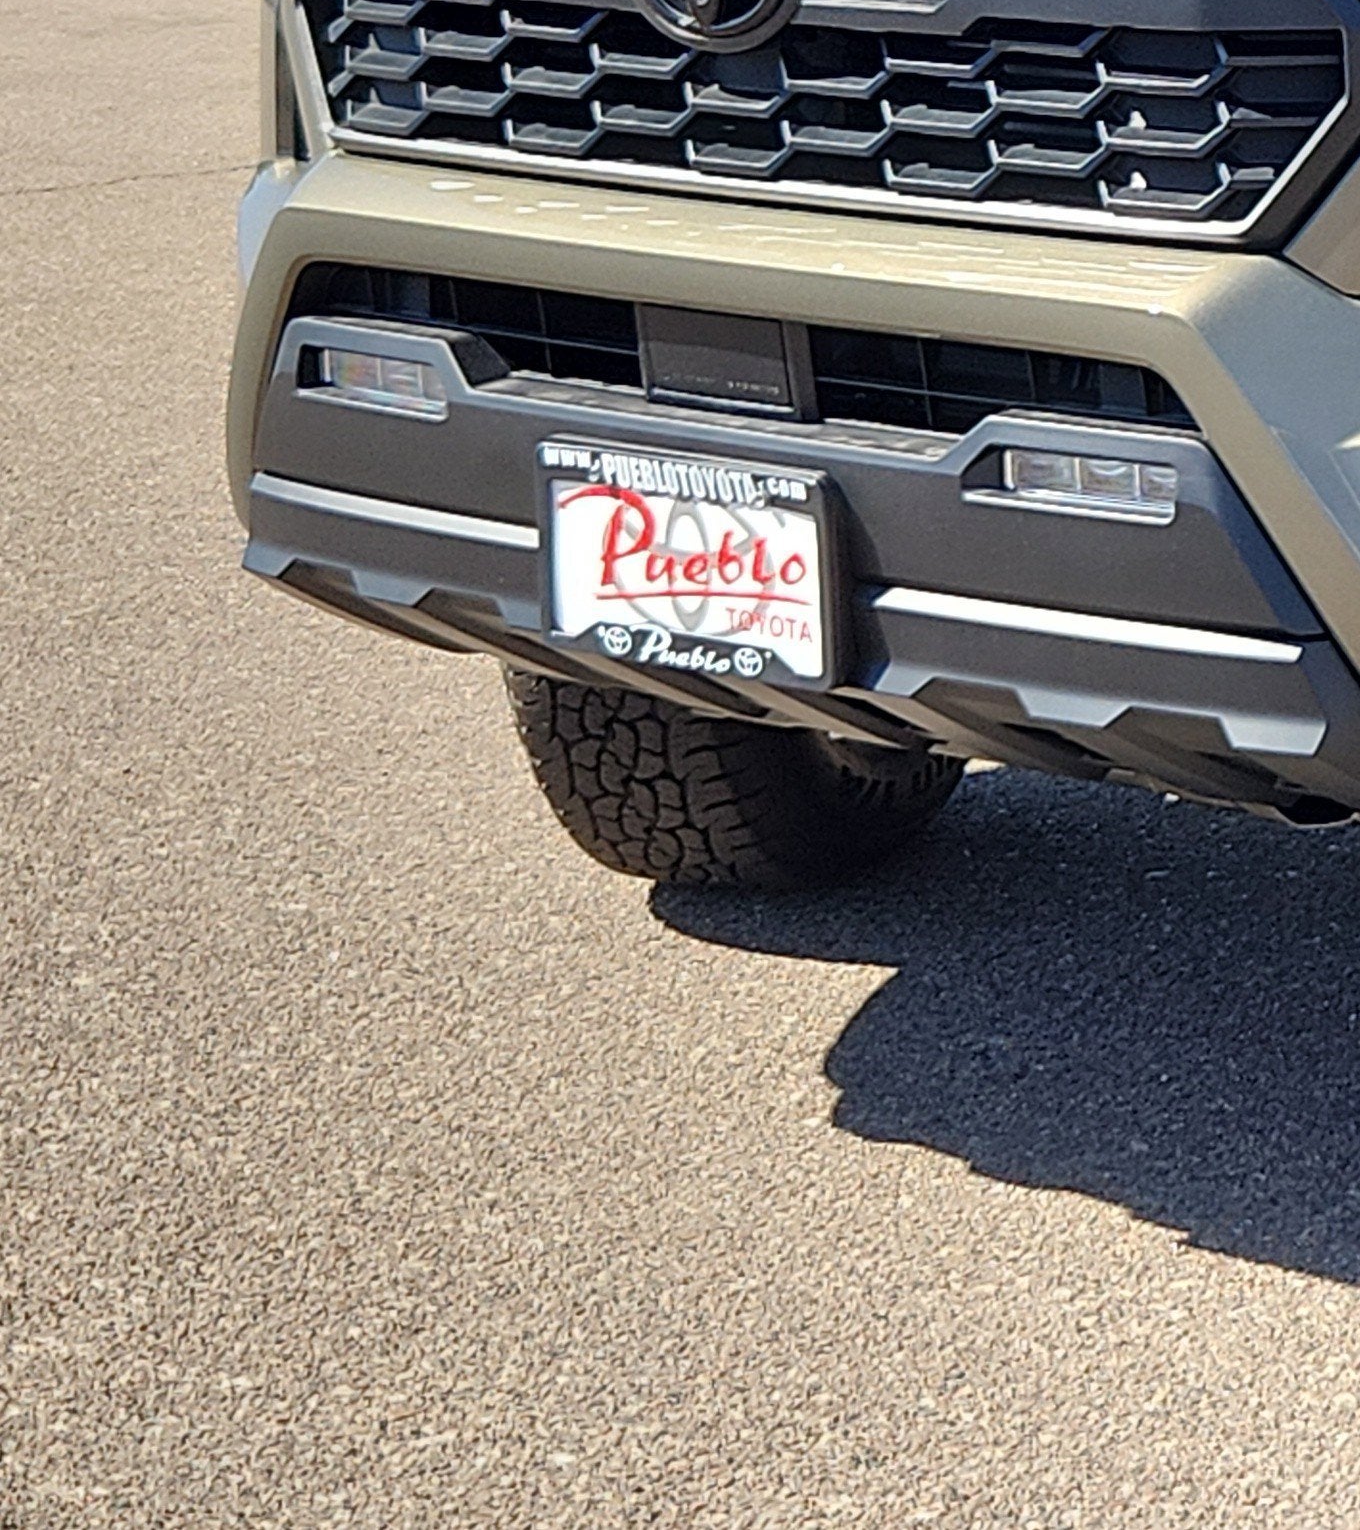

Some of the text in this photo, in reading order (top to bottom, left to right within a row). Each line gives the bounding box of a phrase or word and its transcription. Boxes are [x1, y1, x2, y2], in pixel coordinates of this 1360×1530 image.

[558, 483, 808, 587] Pueblo
[629, 622, 732, 673] Pueblo
[725, 607, 814, 644] TOYOTA
